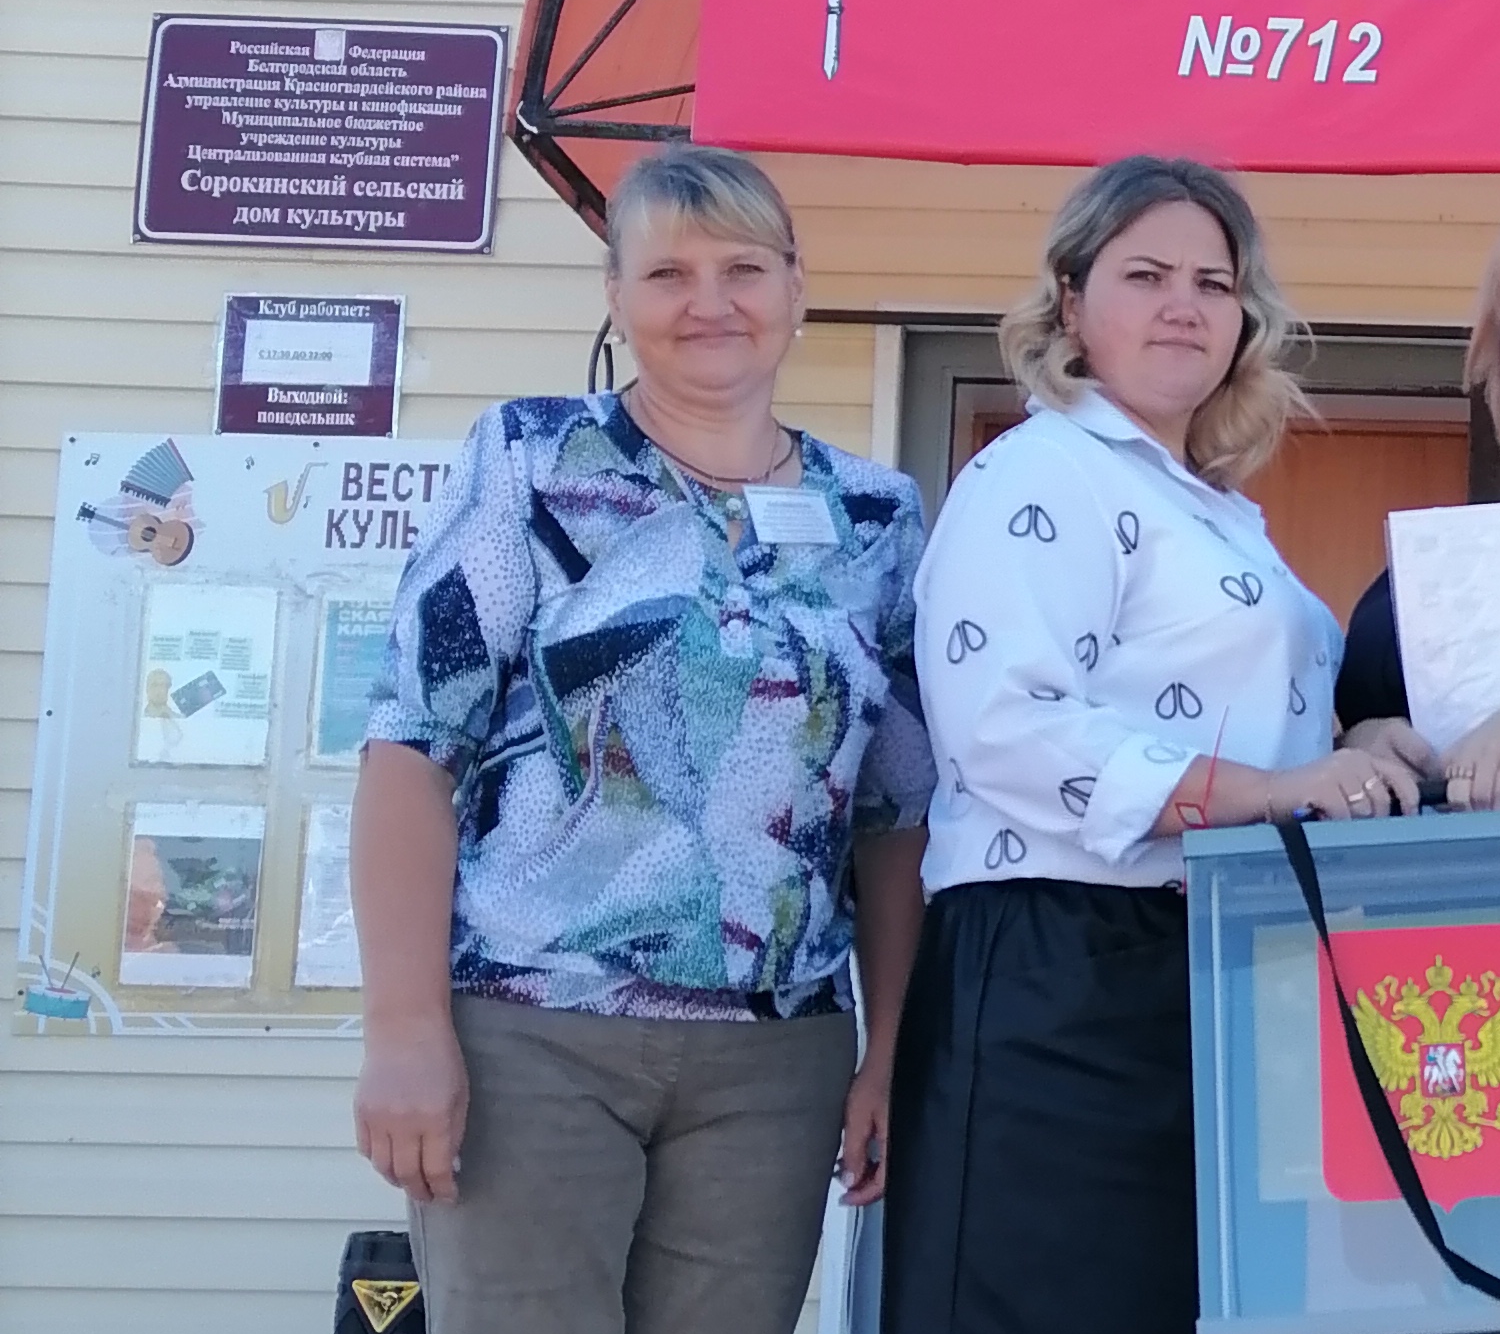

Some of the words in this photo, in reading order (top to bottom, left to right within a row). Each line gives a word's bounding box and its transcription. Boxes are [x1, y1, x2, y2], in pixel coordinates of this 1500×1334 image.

[230, 41, 310, 57] Российская
[349, 45, 426, 62] Федерация
[1178, 15, 1383, 84] №712
[247, 59, 347, 76] Белгородская
[351, 63, 407, 78] область
[163, 73, 281, 93] Администрация
[283, 76, 433, 97] Красногвардейского
[436, 84, 487, 99] района
[185, 95, 271, 110] управление
[274, 98, 345, 114] культуры
[348, 102, 357, 112] и
[362, 100, 462, 116] кинофикации
[222, 110, 341, 129] Муниципальное
[345, 116, 424, 132] бюджетное
[240, 132, 327, 147] учреждение
[330, 135, 402, 151] культуры
[330, 152, 390, 168] клубная
[180, 168, 347, 198] Сорокинский
[352, 177, 466, 200] сельский
[232, 207, 280, 225] дом
[286, 208, 406, 232] культуры
[258, 299, 296, 318] Клуб
[300, 301, 371, 318] работает:
[267, 387, 348, 405] Выходной:
[257, 411, 356, 426] понедельник
[341, 462, 451, 502] ВЕСТ
[325, 509, 419, 549] КУЛЬ
